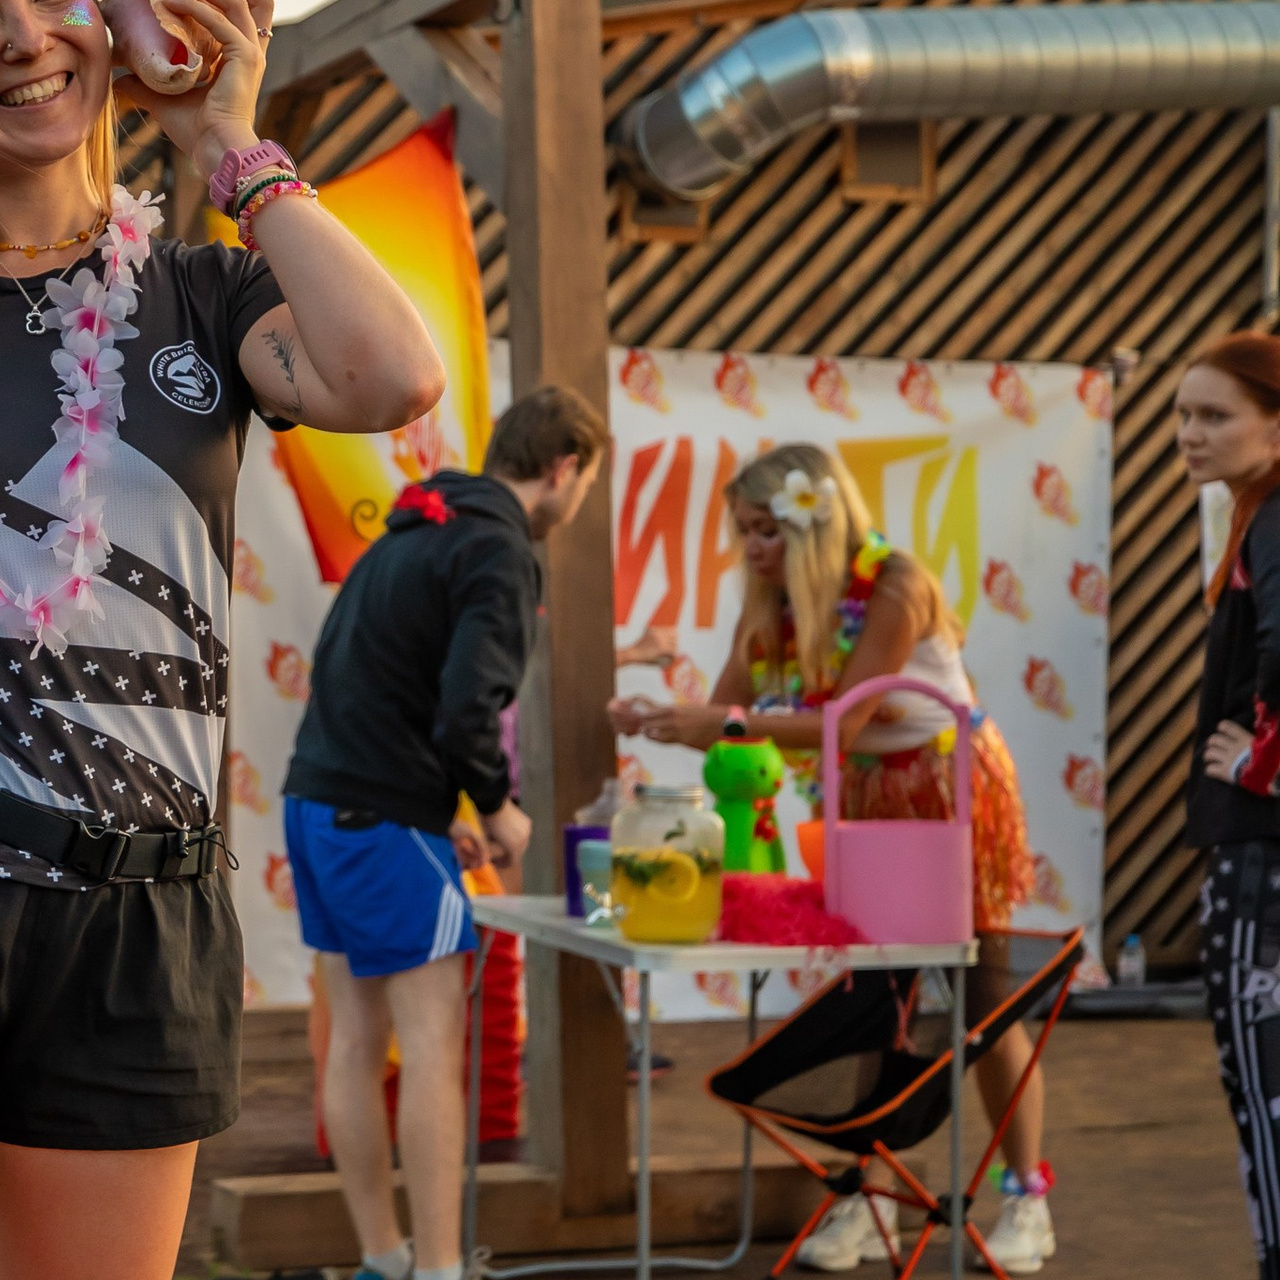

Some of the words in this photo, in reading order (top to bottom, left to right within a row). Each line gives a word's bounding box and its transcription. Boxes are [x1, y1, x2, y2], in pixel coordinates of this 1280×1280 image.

[157, 354, 170, 377] WHITE
[172, 346, 195, 358] BRID
[197, 361, 211, 383] LTRA
